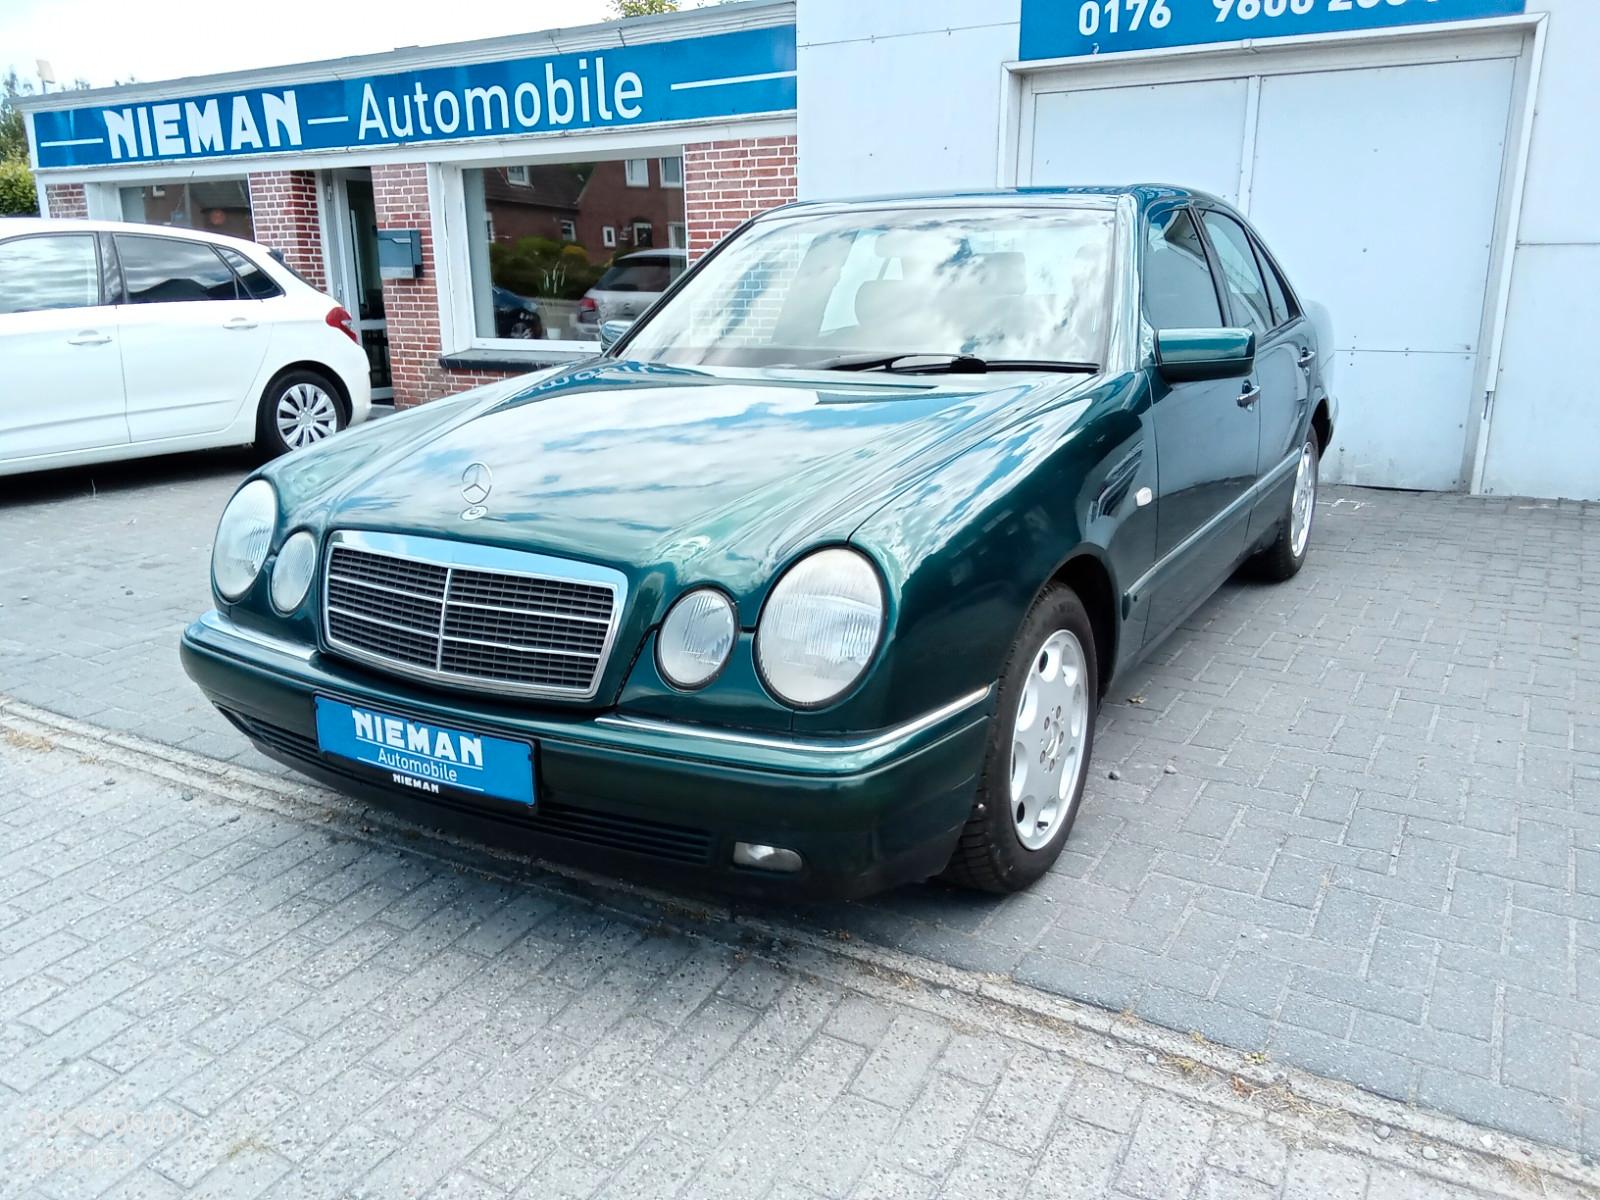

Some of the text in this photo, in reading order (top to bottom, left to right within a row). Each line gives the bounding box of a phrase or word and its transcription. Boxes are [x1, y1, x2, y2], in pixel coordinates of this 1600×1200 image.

[1078, 0, 1172, 36] 0176
[103, 57, 643, 159] NIEMAN Automobile
[351, 709, 483, 766] NIEMAN
[378, 747, 457, 782] Automobile
[392, 773, 440, 793] NIEMAN
